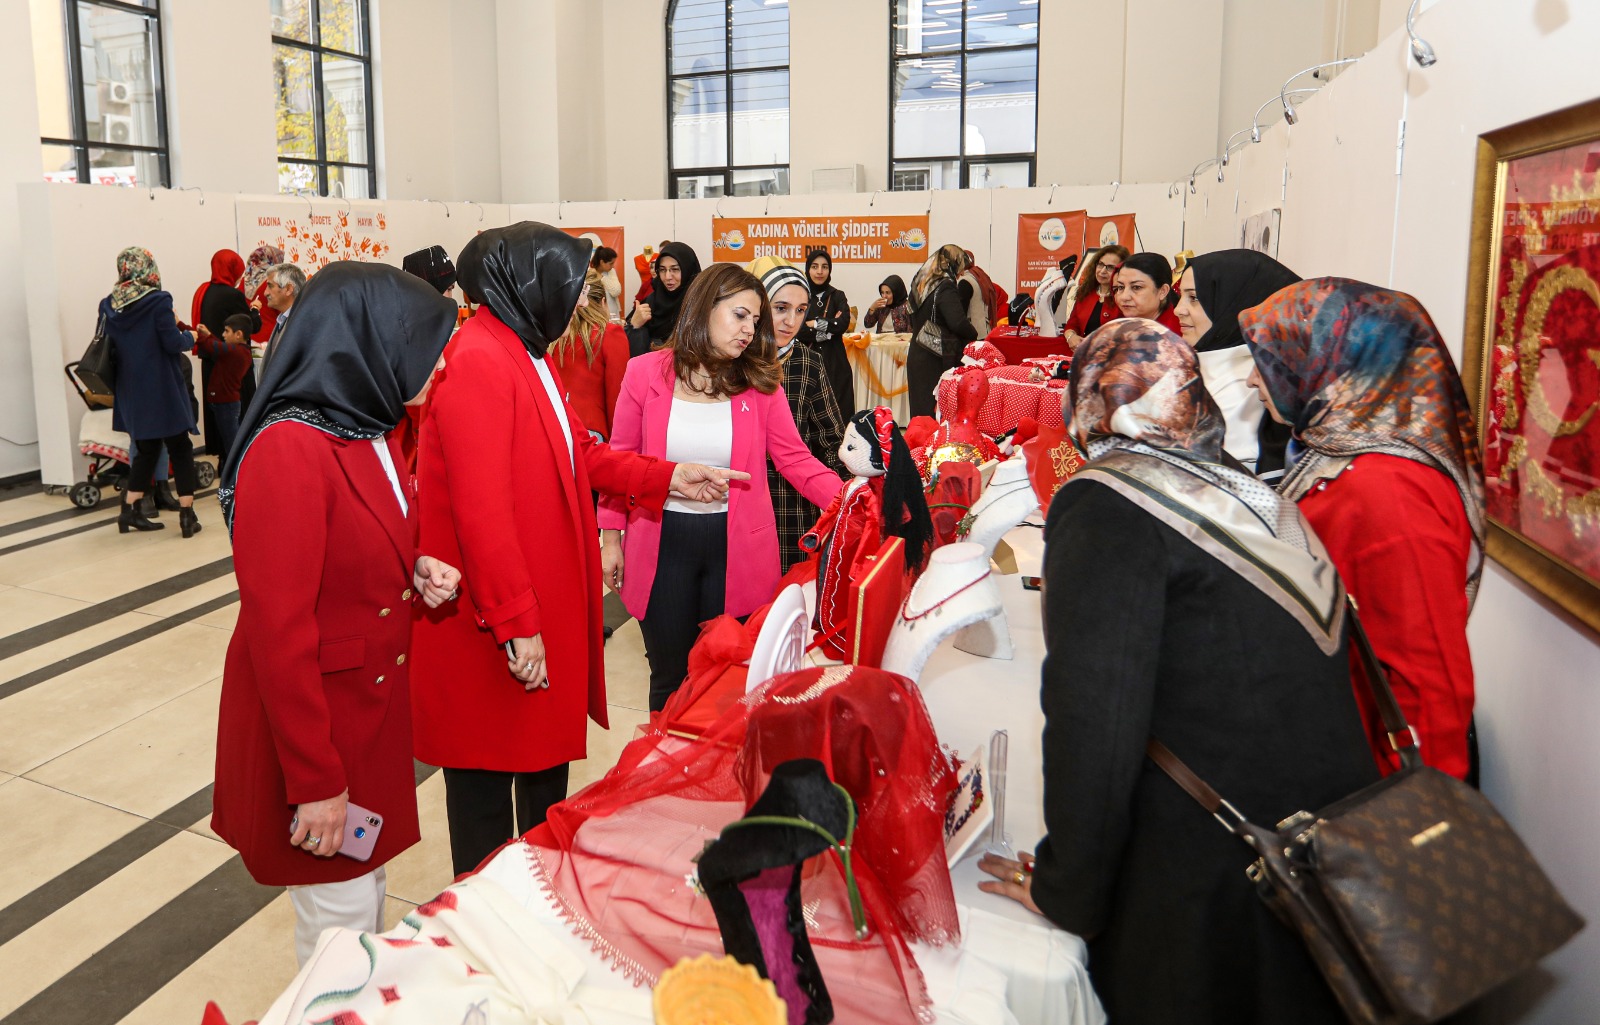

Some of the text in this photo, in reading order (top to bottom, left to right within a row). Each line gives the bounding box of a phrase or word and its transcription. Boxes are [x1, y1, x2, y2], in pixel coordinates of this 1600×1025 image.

[258, 217, 281, 226] KADINA
[357, 217, 373, 227] HAYIR
[747, 220, 890, 240] KADINA YÖNELİK ŞİDDETE
[753, 241, 802, 258] BİRLİKTE
[831, 241, 881, 259] DİYELİM!
